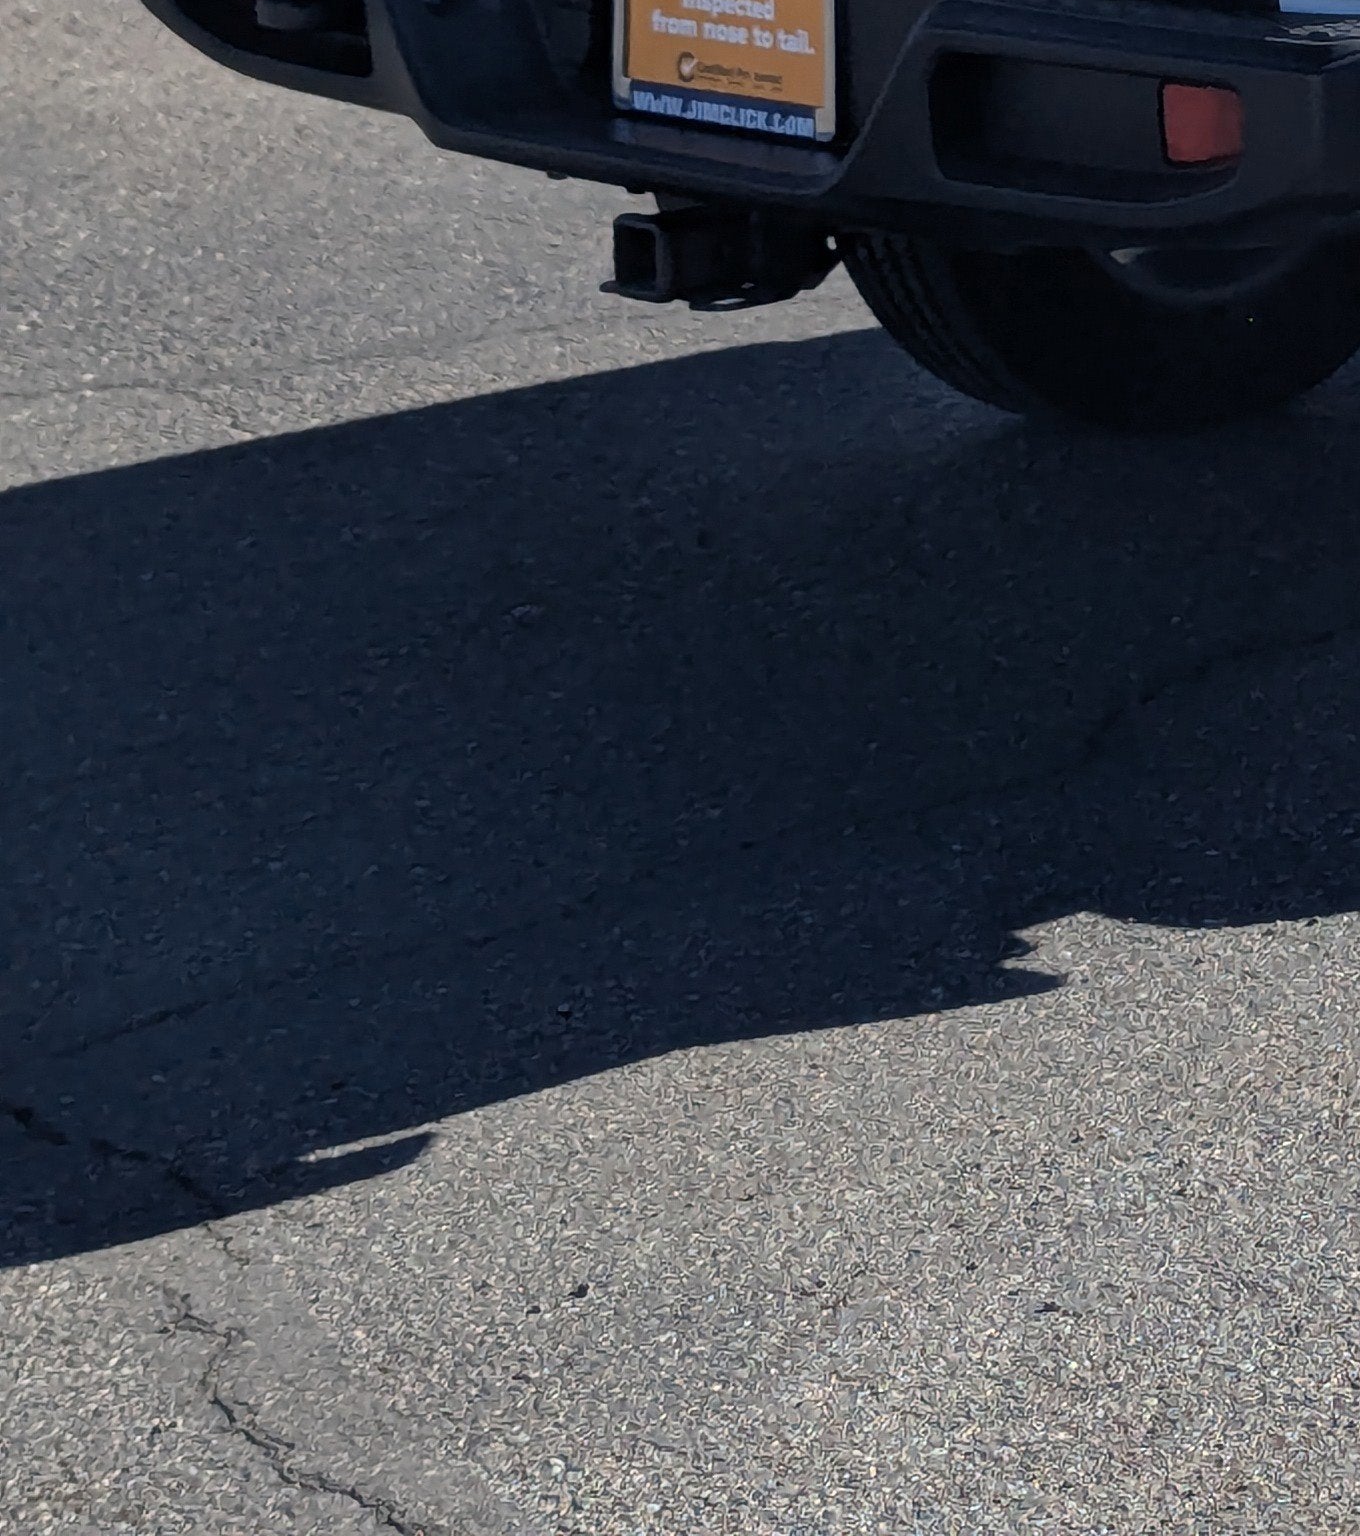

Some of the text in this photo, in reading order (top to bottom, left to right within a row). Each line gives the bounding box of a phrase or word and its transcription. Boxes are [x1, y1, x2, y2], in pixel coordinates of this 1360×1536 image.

[652, 9, 816, 55] from nose to tail.
